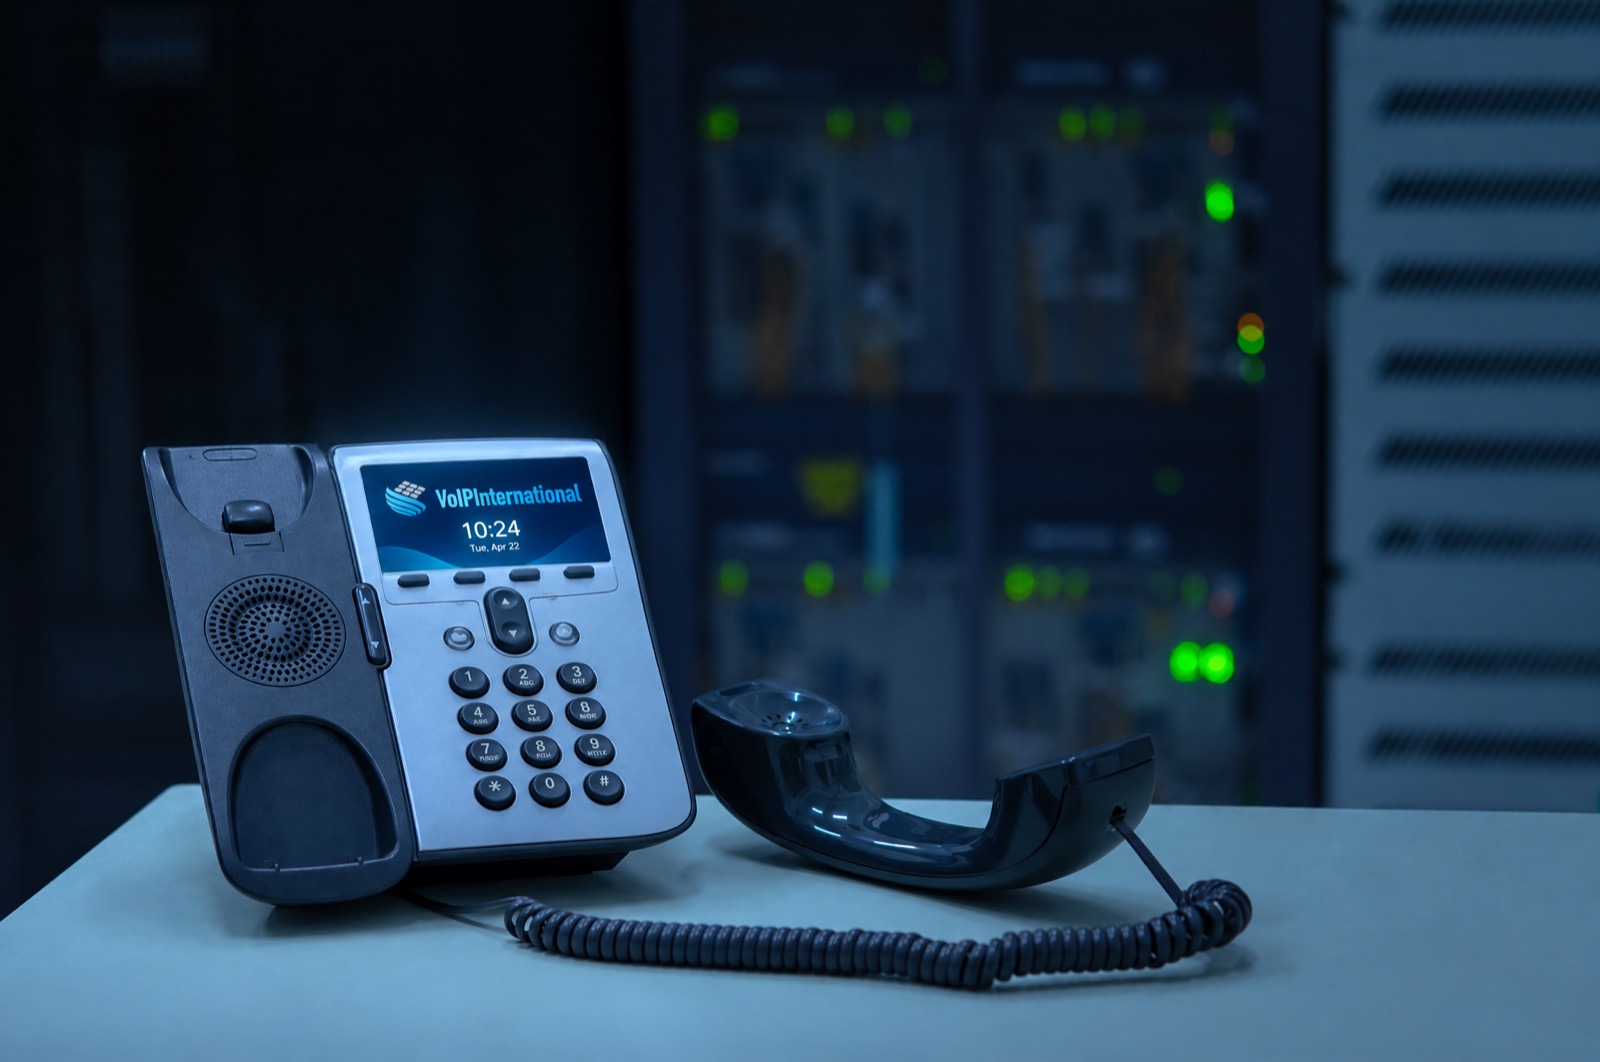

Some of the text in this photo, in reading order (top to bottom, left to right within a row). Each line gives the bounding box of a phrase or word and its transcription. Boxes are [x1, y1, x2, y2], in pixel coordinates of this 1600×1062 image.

[434, 483, 582, 508] VoIPInternational
[462, 519, 521, 539] 10:24
[469, 541, 520, 553] Tue, Apr 22
[465, 671, 472, 681] 1
[519, 669, 529, 679] 2
[572, 666, 581, 677] 3
[474, 707, 483, 717] 4
[527, 705, 537, 715] 5
[481, 743, 489, 754] 7
[536, 740, 545, 751] 8
[589, 738, 599, 749] 9
[545, 777, 554, 788] 0
[600, 775, 609, 786] #
